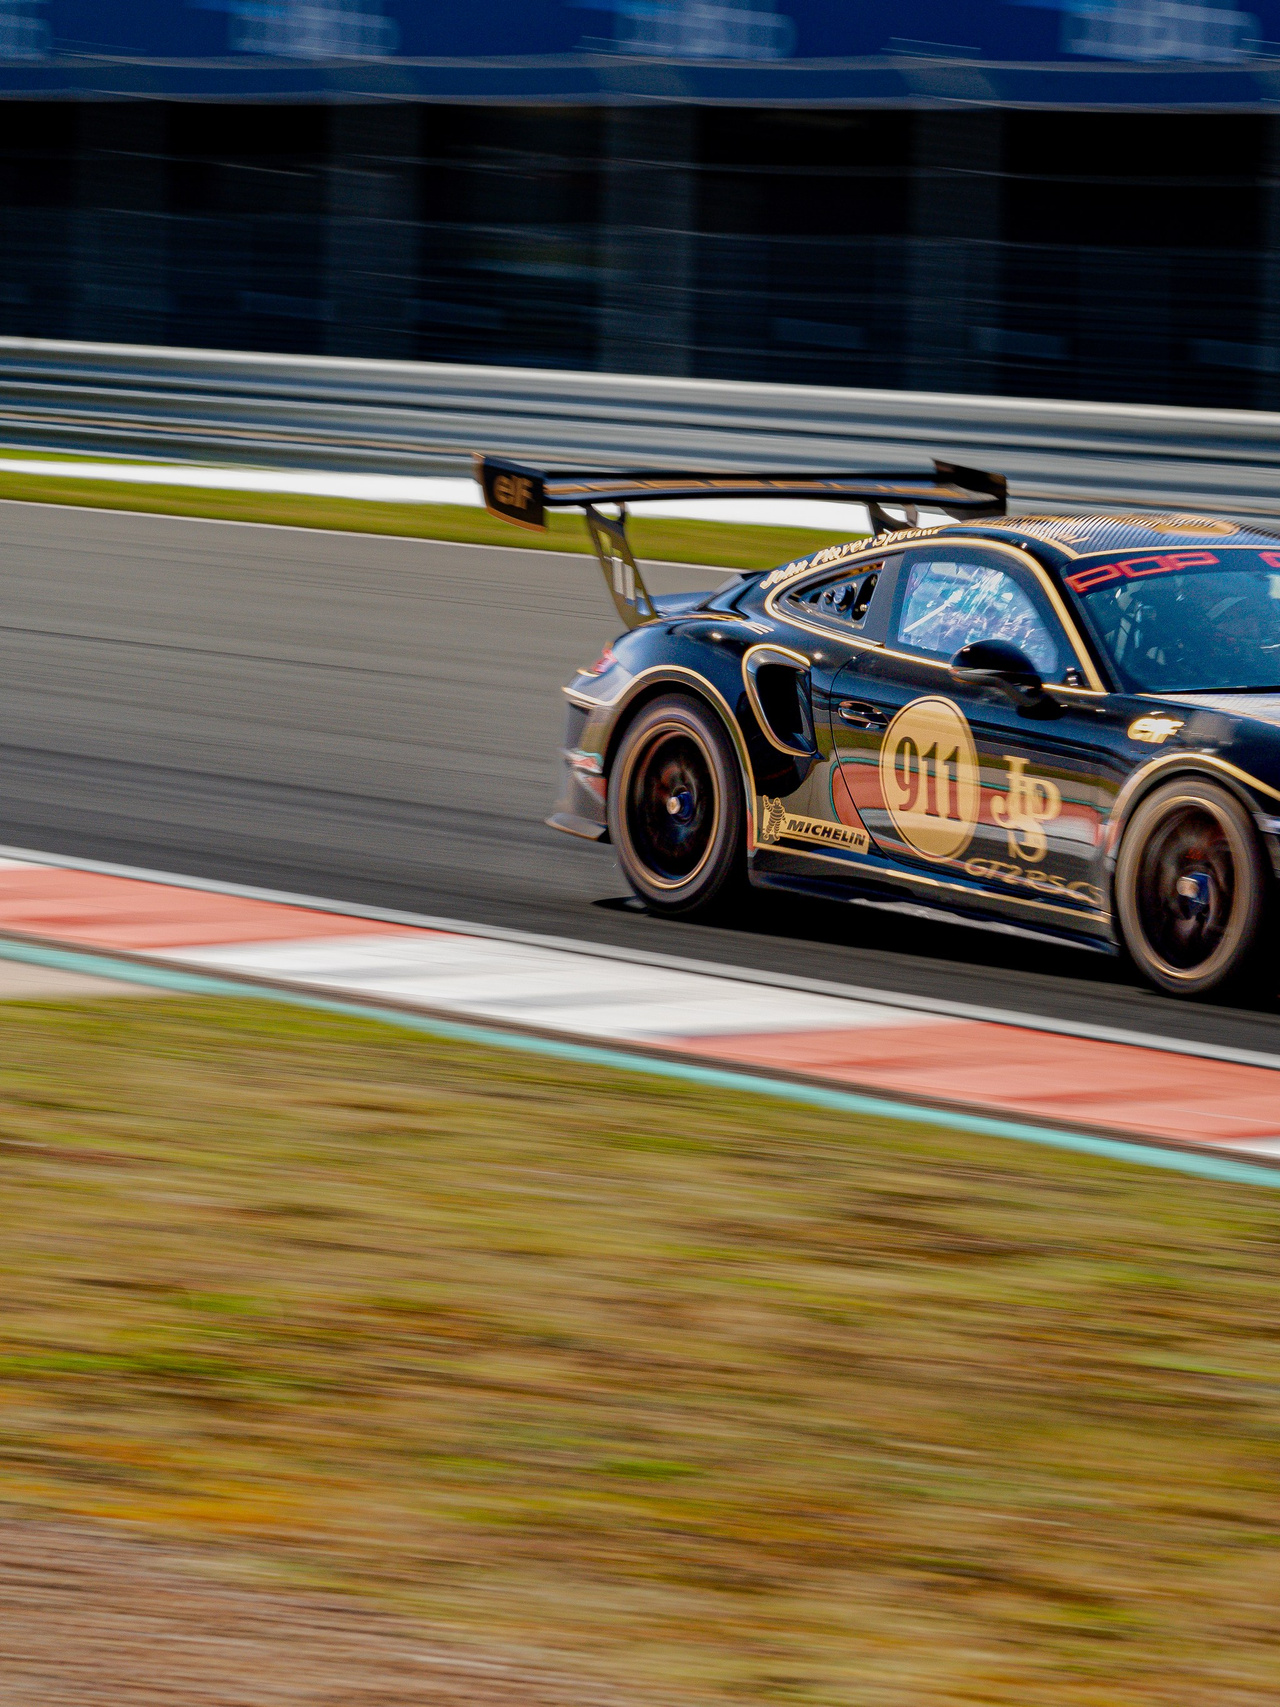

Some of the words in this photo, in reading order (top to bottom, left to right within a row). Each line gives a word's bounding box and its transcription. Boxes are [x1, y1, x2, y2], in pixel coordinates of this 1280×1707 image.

[760, 560, 808, 590] John
[809, 537, 873, 567] Player
[894, 736, 962, 823] 911
[787, 819, 866, 847] MICHELIN
